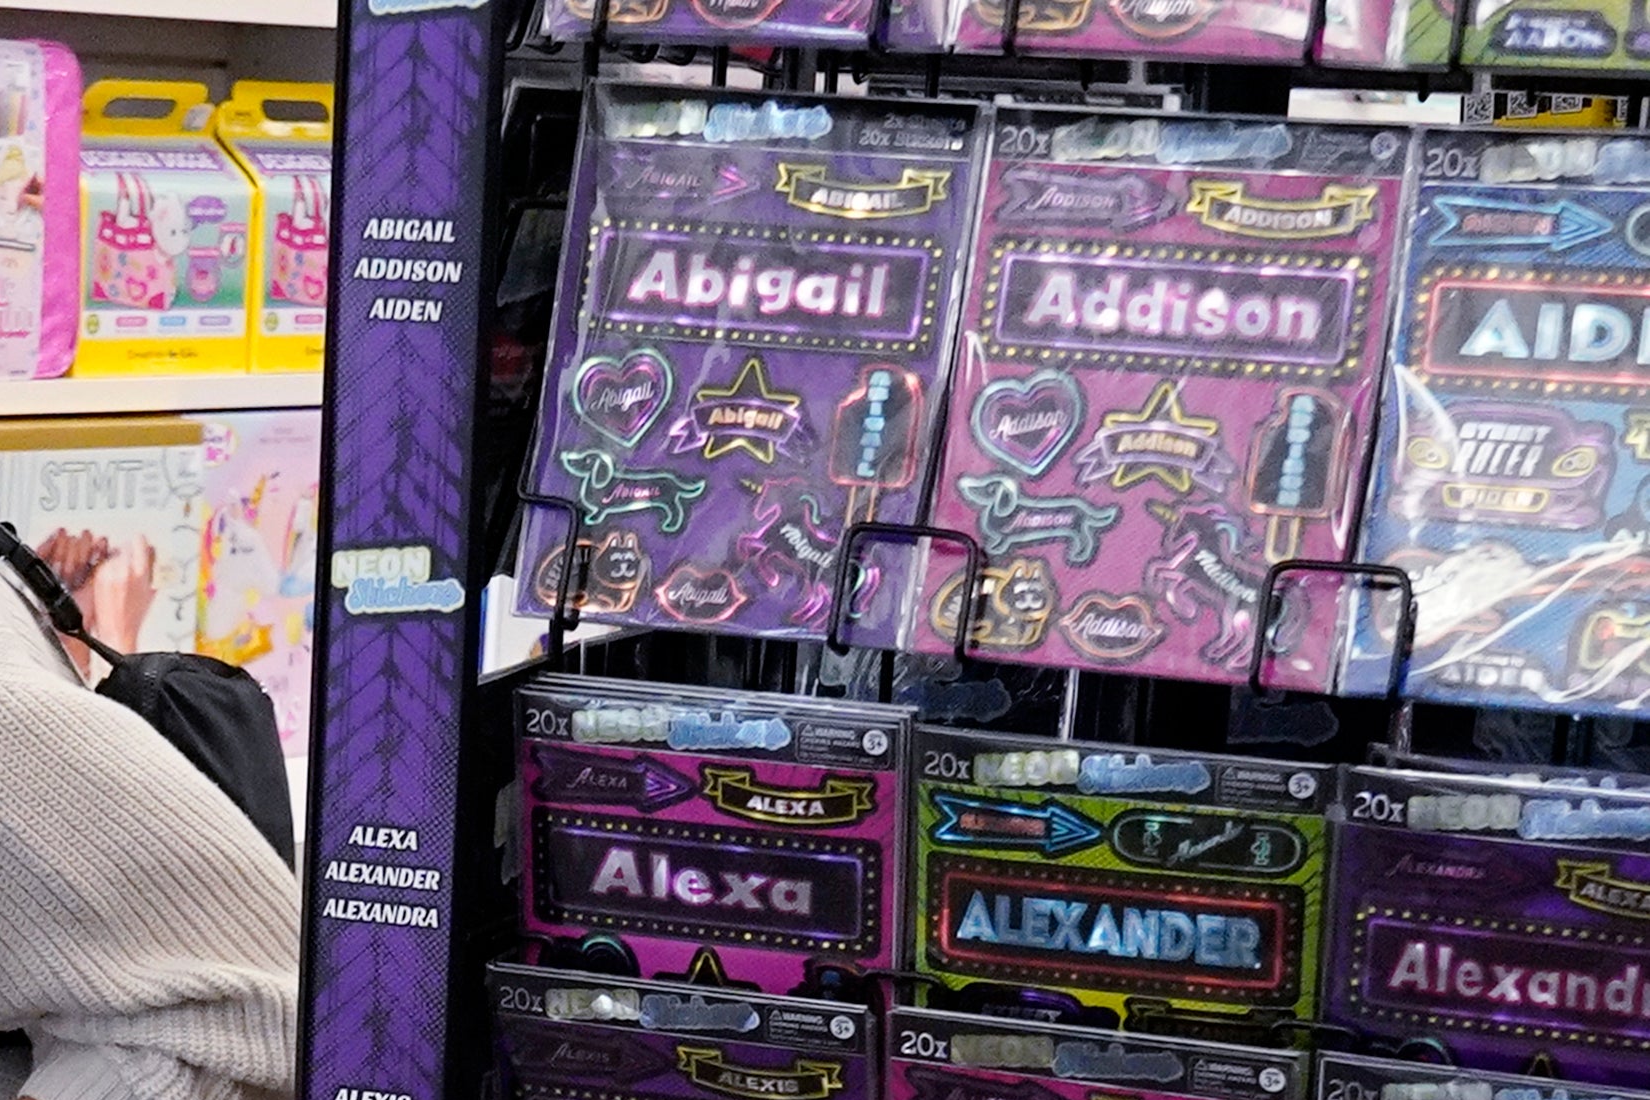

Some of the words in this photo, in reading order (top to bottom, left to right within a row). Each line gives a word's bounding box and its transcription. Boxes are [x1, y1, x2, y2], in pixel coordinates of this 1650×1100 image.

[998, 125, 1051, 156] 20x
[1425, 147, 1479, 177] 20x
[810, 186, 903, 211] ABIGAIL
[363, 218, 456, 243] ABIGAIL
[1223, 205, 1333, 231] ADDISON
[353, 257, 463, 283] ADDISON
[626, 249, 889, 317] Abigail
[369, 298, 443, 322] AIDEN
[1024, 268, 1322, 342] Addison
[708, 405, 782, 431] Abigail
[1116, 433, 1198, 457] Addison
[1451, 440, 1542, 477] RACER
[38, 457, 144, 512] STMT
[333, 547, 430, 583] NEON
[348, 575, 463, 611] Stickers
[525, 708, 570, 737] 20x
[923, 750, 970, 780] 20x
[746, 795, 825, 817] ALEXA
[1351, 791, 1407, 823] 20x
[348, 824, 418, 852] ALEXA
[324, 860, 441, 891] ALEXANDER
[589, 846, 815, 918] Alexa
[322, 897, 439, 930] ALEXANDRA
[955, 888, 1262, 970] ALEXANDER
[498, 985, 545, 1013] 20x
[899, 1029, 948, 1060] 20x
[717, 1071, 800, 1095] ALEXIS
